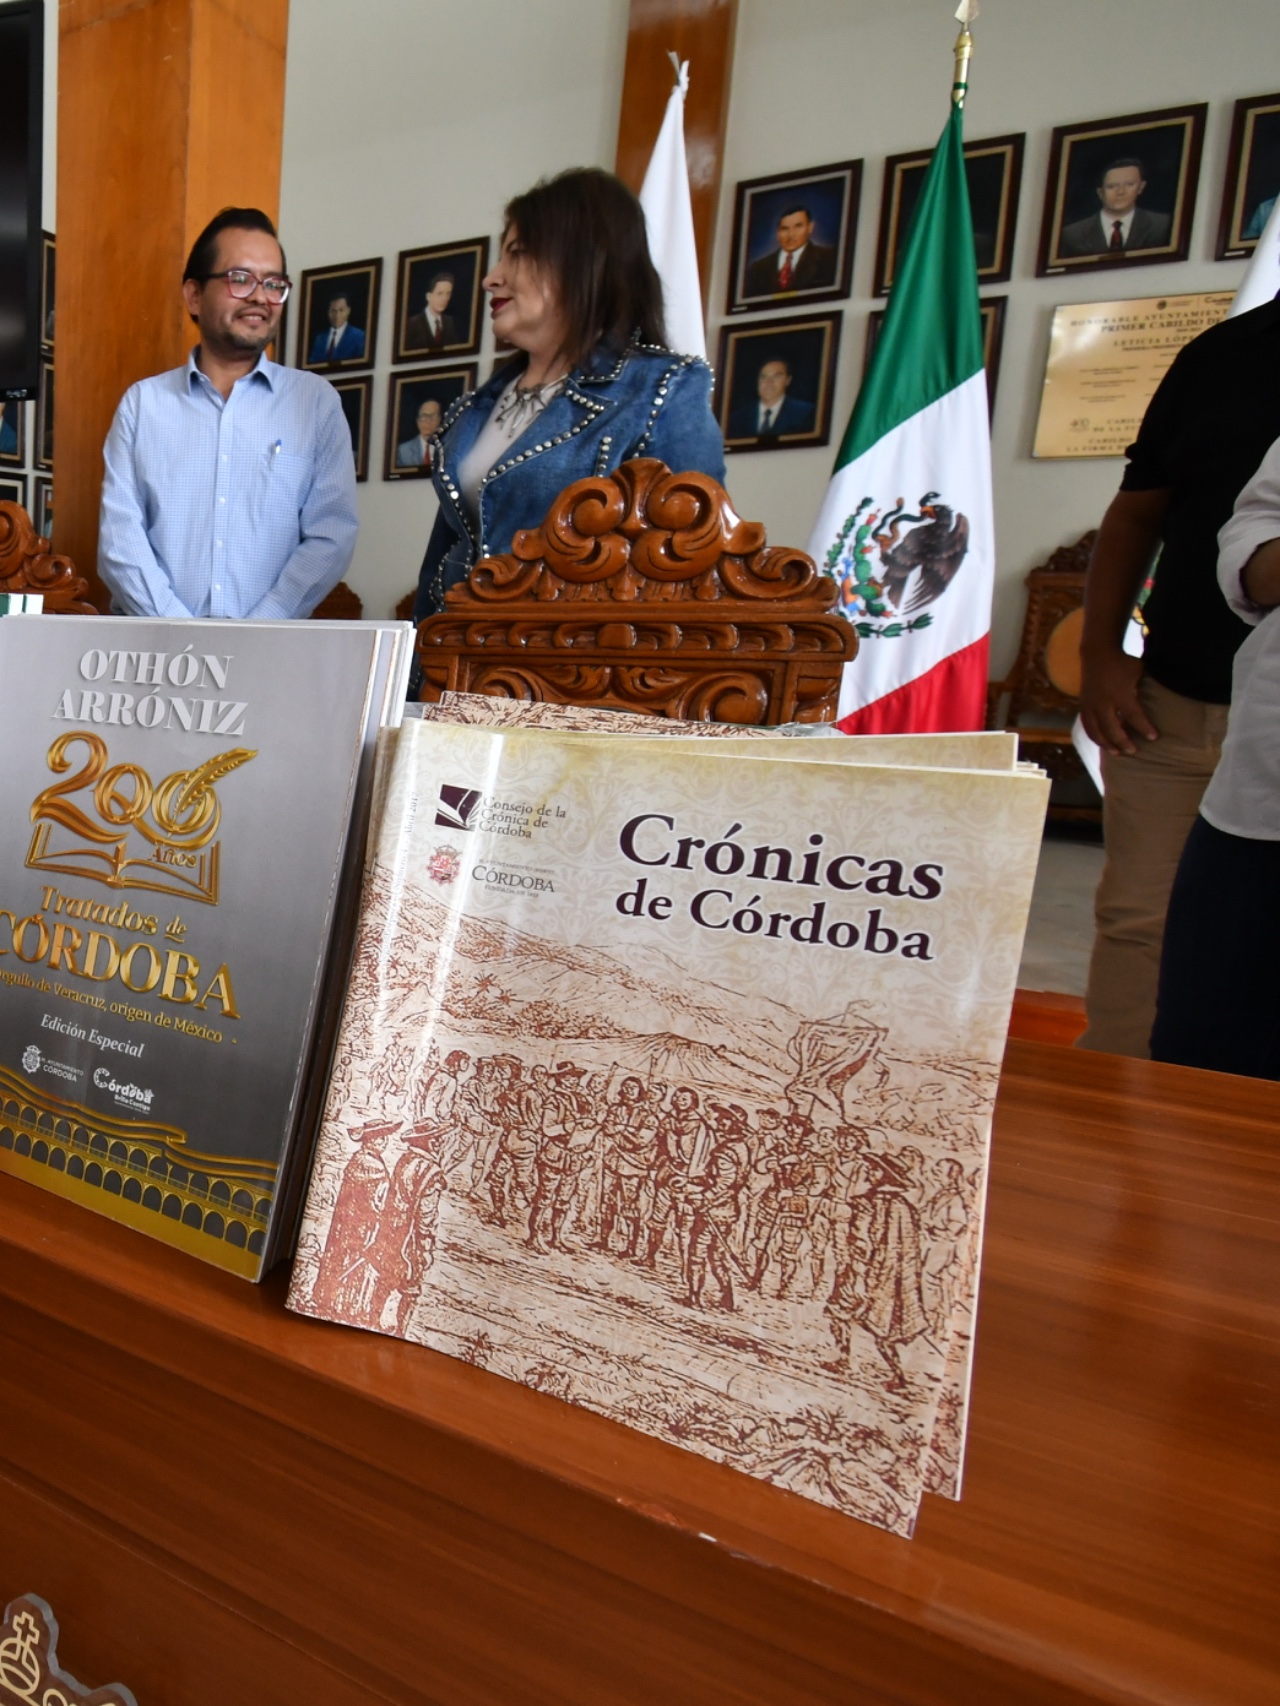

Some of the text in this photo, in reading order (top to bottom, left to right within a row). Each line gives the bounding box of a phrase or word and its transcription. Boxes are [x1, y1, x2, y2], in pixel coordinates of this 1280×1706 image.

[1101, 323, 1145, 333] PRIMER
[1149, 318, 1204, 330] CABILDO
[1144, 308, 1228, 320] AYUNTAMIENT
[79, 643, 234, 689] OTHÓN
[51, 686, 249, 736] ARRÓNIZ
[481, 808, 549, 828] Crónica de
[484, 797, 566, 818] Consejo de la
[479, 820, 532, 838] Córdoba
[147, 845, 197, 868] Años
[619, 813, 944, 901] Crónicas
[472, 865, 555, 893] CÓRDOBA
[41, 885, 187, 940] Tratados de
[616, 877, 934, 961] de Córdoba
[36, 977, 51, 994] de
[53, 982, 108, 1012] Veracruz,
[110, 1002, 152, 1023] origen
[155, 1012, 172, 1029] de
[173, 1017, 223, 1044] México
[40, 1013, 145, 1059] Edición Especial
[93, 1067, 155, 1104] Córdoba
